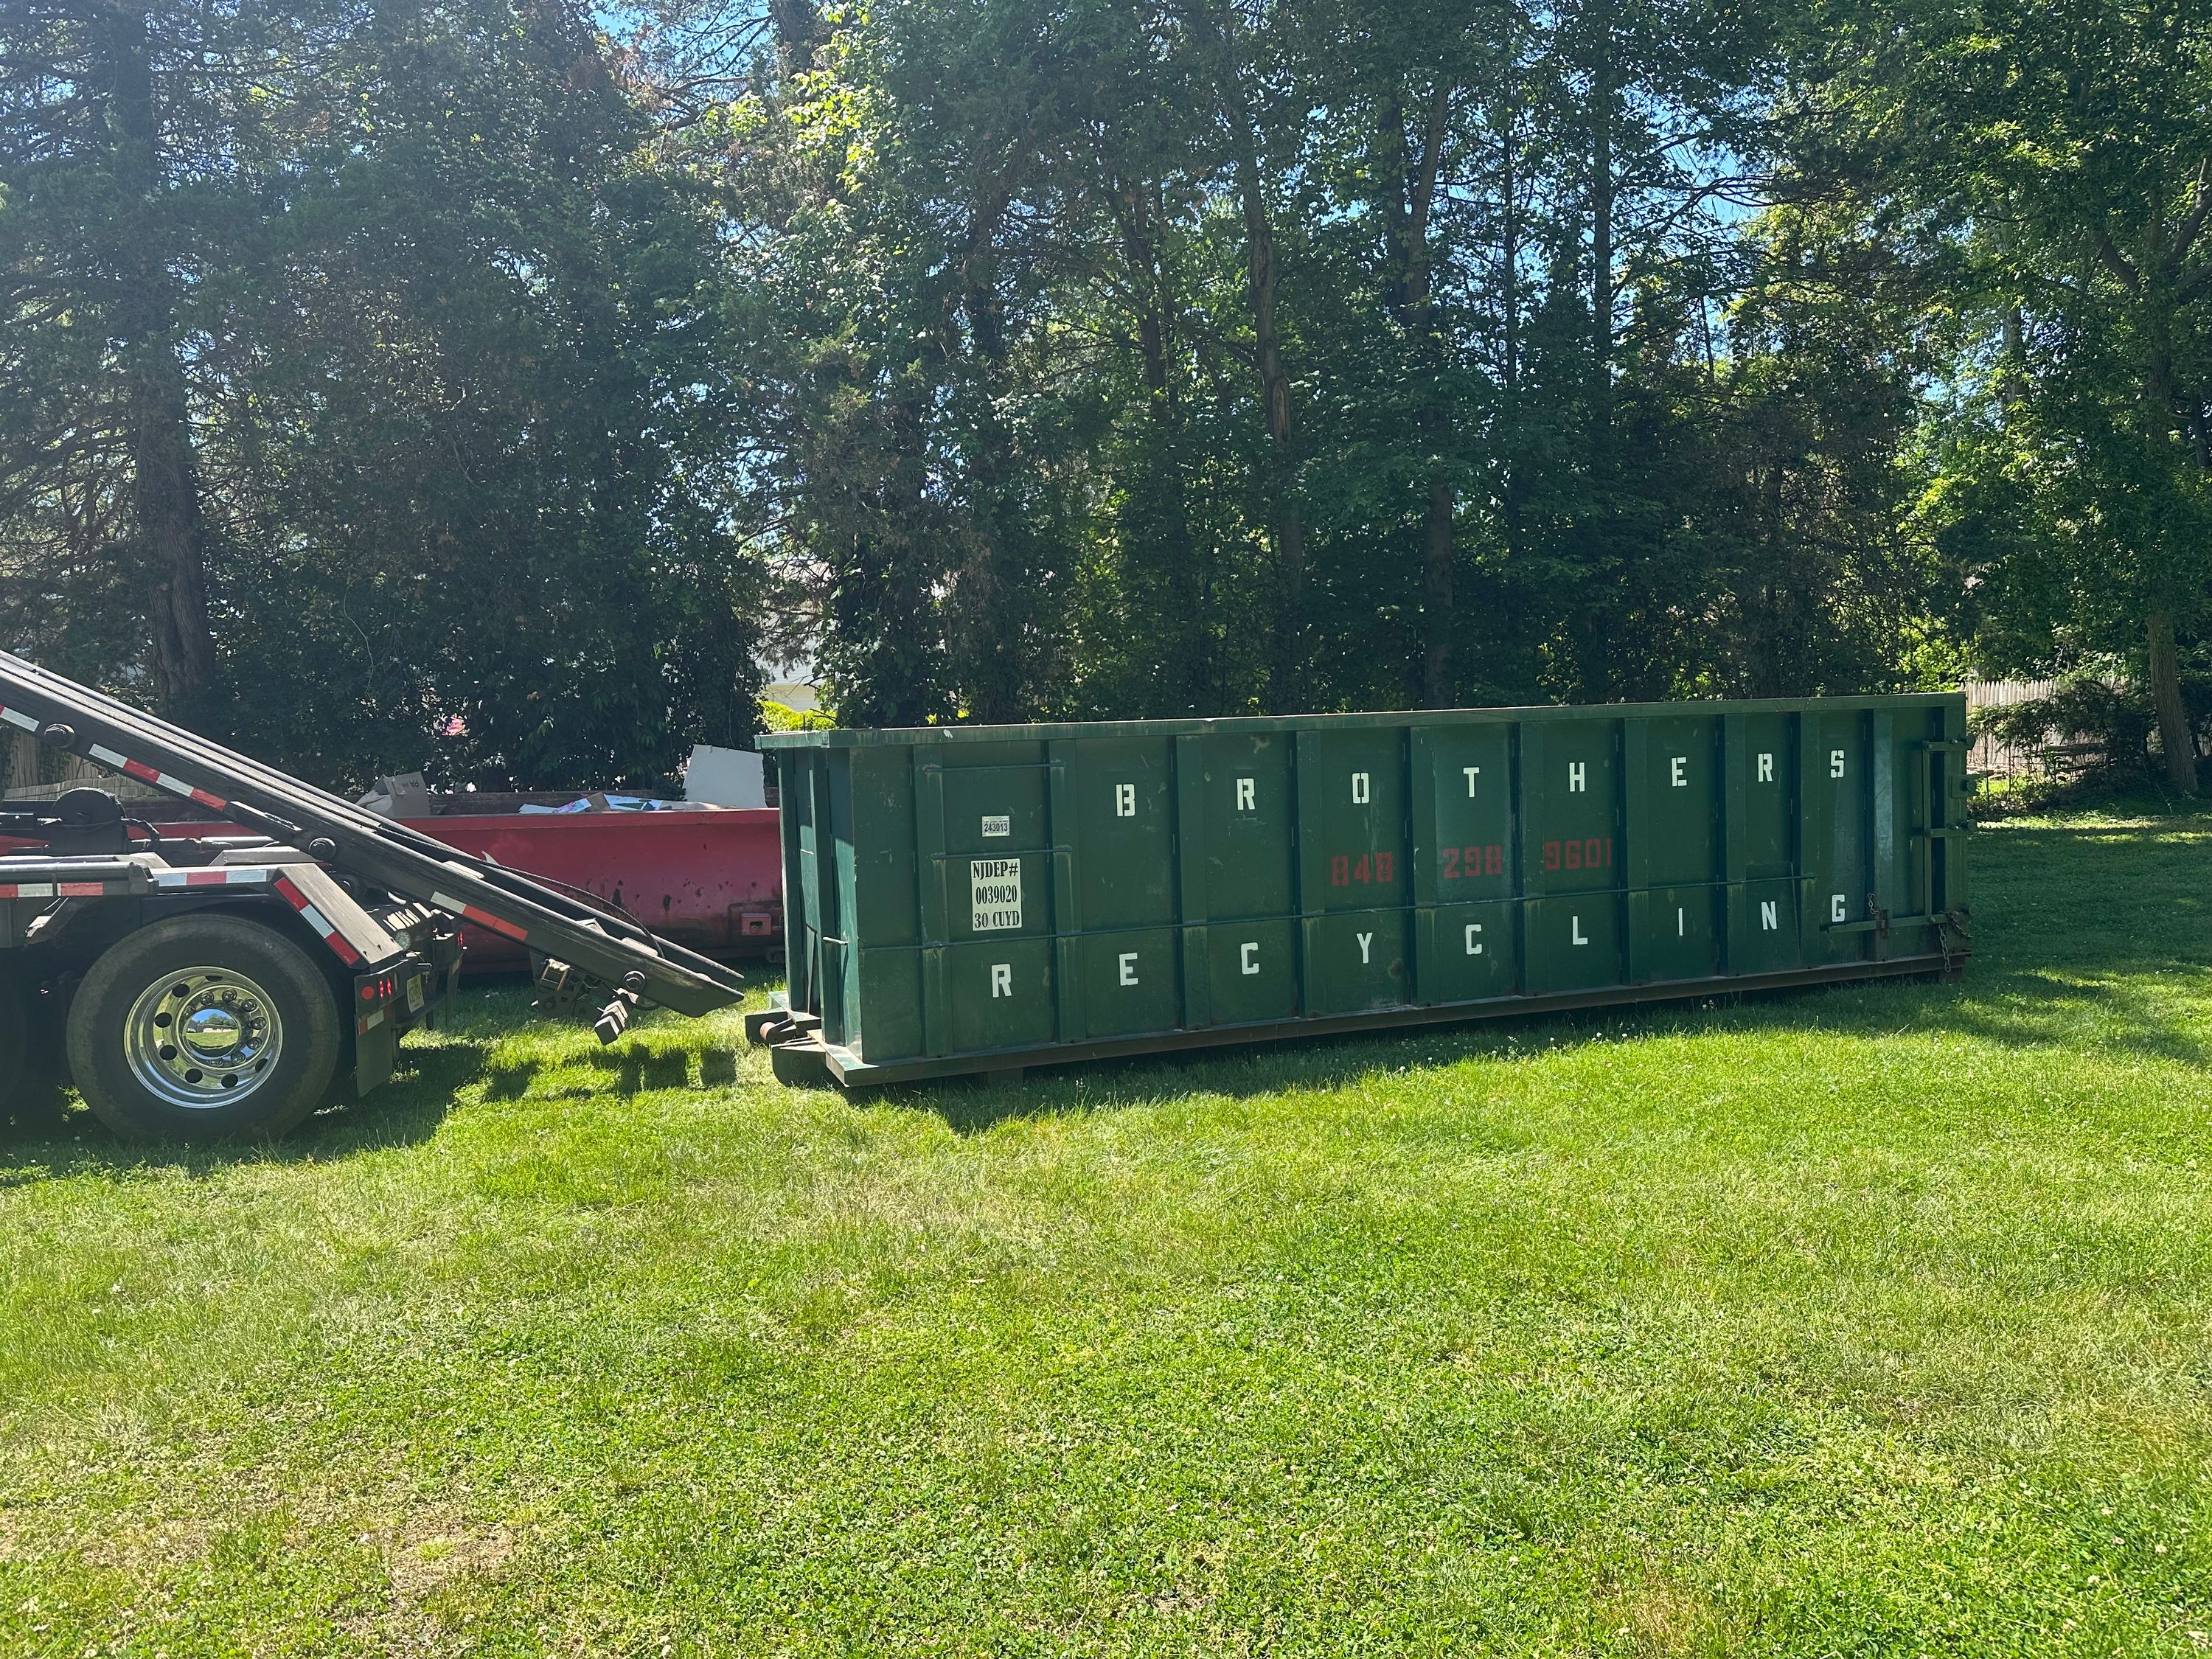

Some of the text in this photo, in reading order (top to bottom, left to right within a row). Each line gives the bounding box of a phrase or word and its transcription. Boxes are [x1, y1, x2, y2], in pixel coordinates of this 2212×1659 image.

[1116, 750, 1844, 817] BROTHERS
[984, 823, 1008, 832] 243013
[973, 861, 1018, 880] NJDEP#
[1332, 838, 1613, 886] 848 298 9601
[975, 885, 1018, 905] 0039020
[974, 911, 1020, 928] 30 CUYD
[991, 894, 1846, 998] RECYCLING
